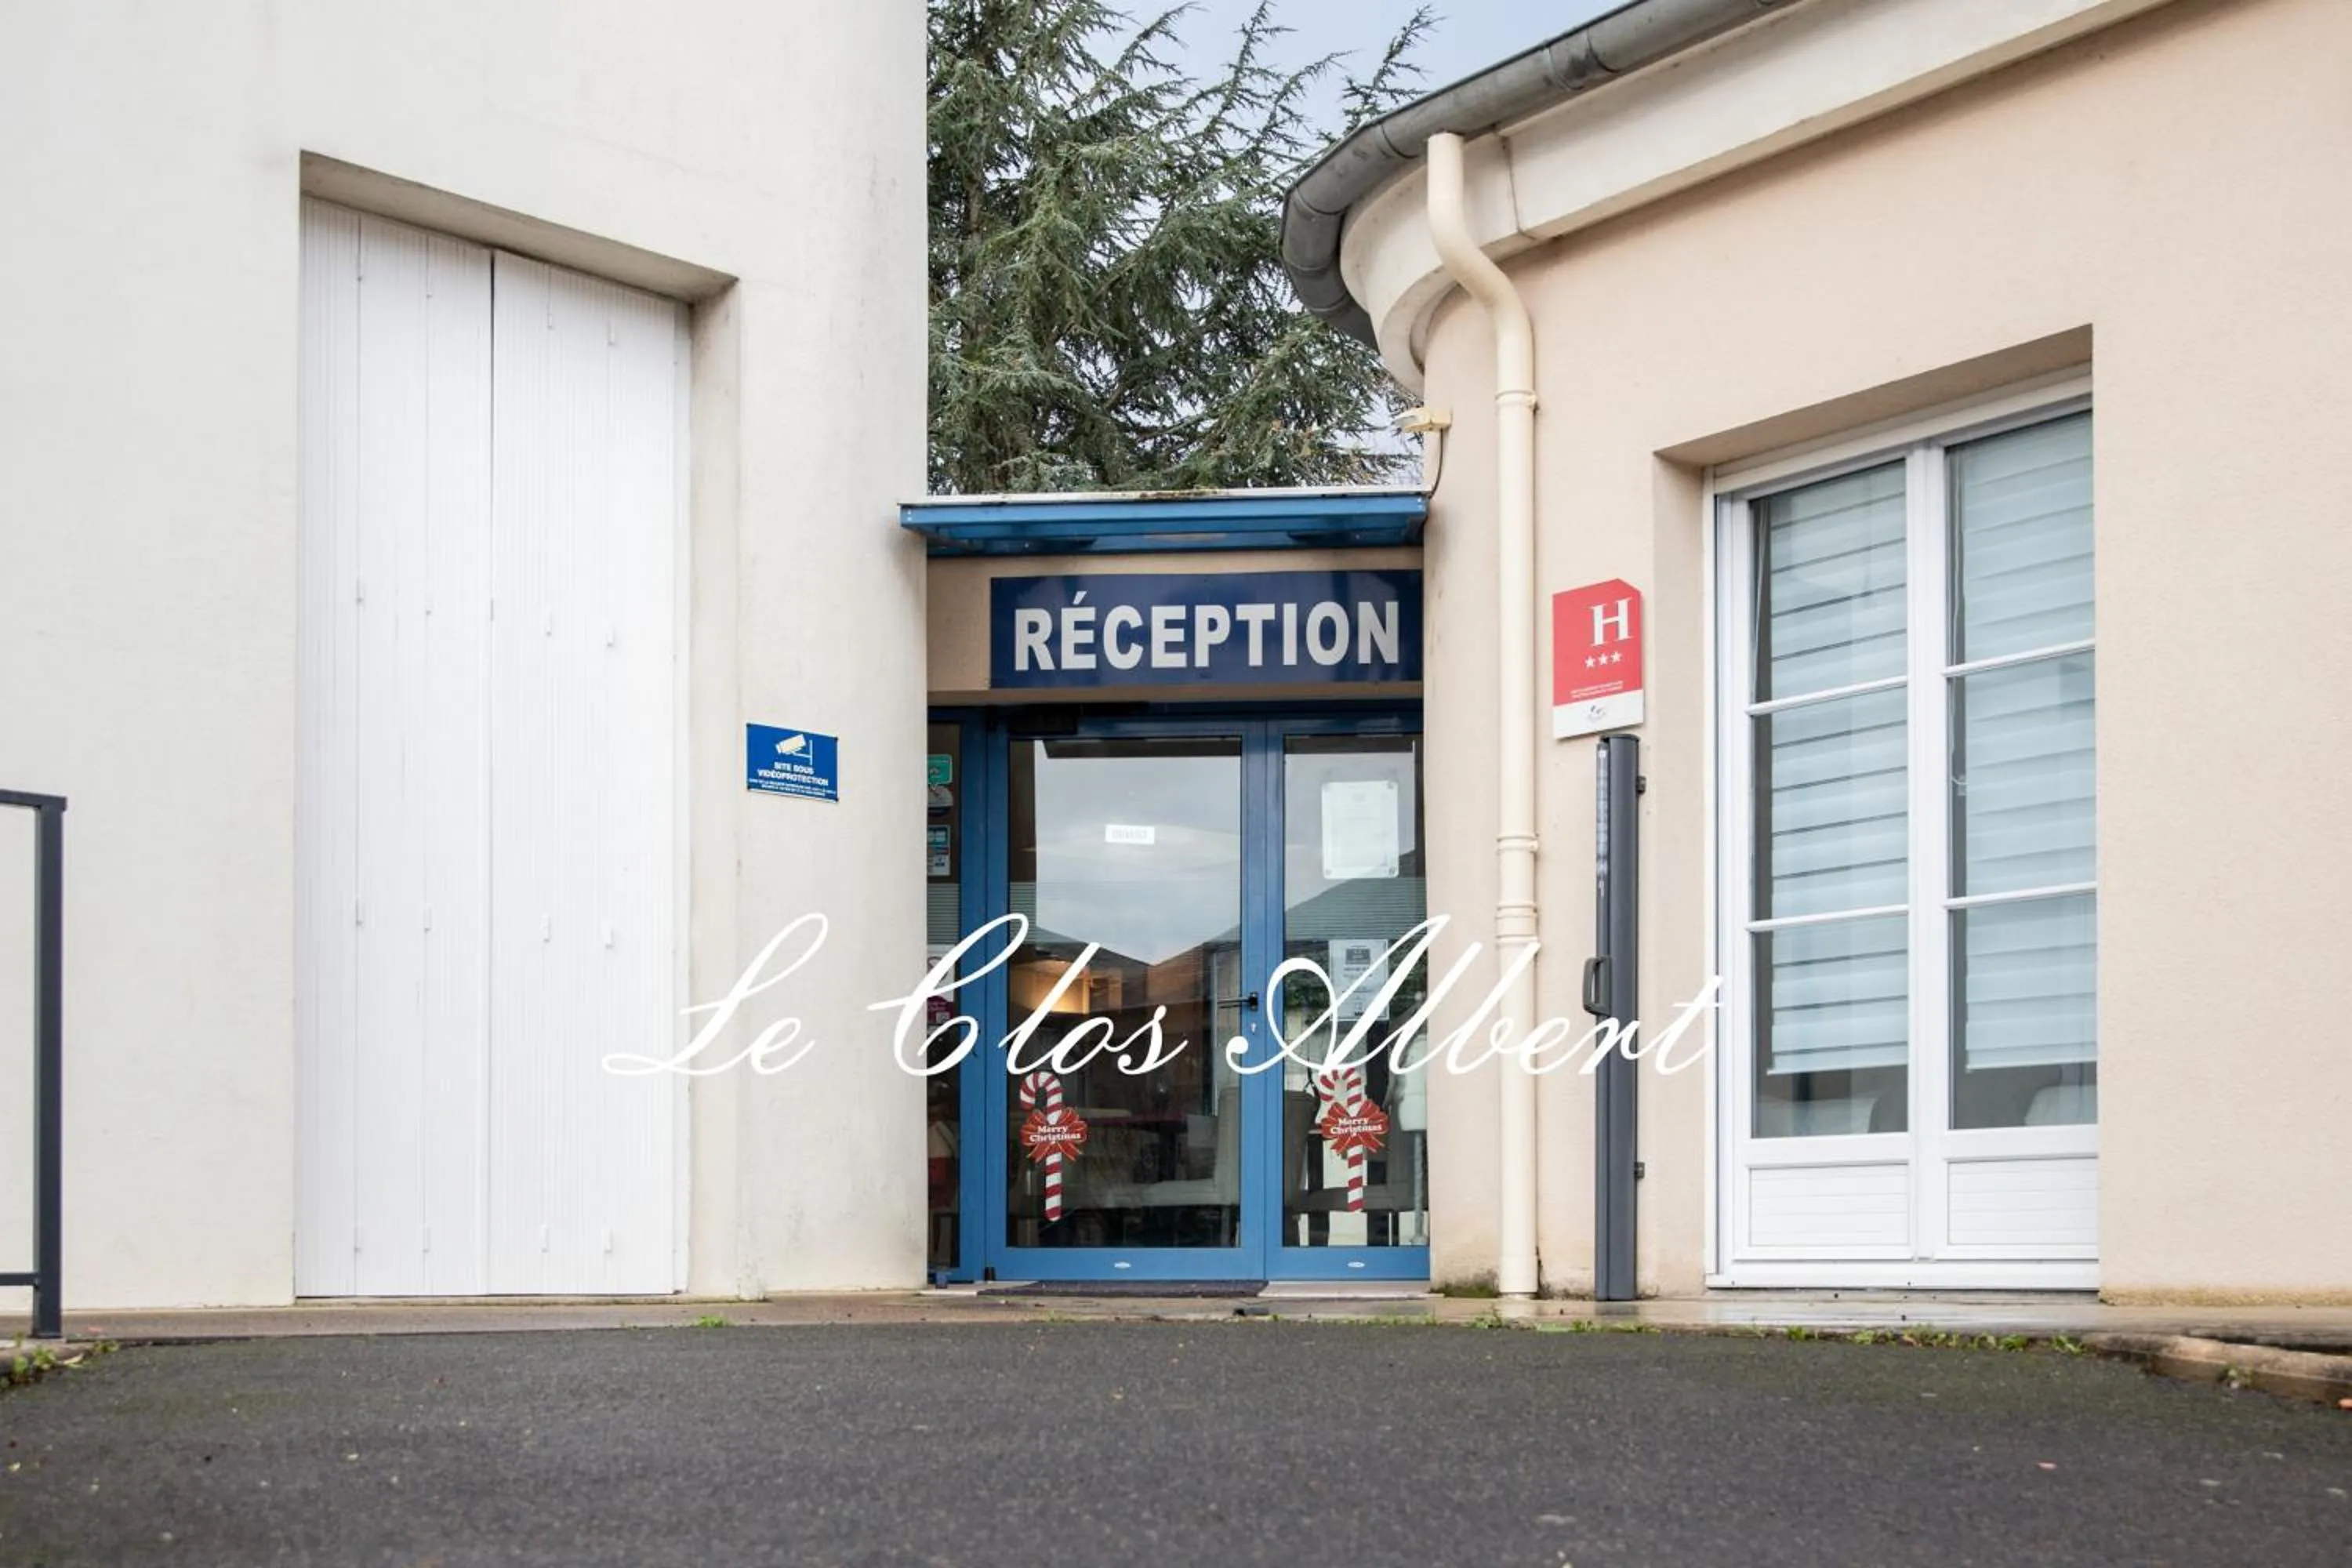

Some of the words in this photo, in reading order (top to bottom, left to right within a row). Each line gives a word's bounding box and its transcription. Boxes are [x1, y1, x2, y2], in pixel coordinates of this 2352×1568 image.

[1590, 597, 1634, 646] H
[1016, 591, 1399, 670] RÉCEPTION
[1338, 1118, 1370, 1127] Merry
[1037, 1125, 1069, 1135] Merry
[1330, 1125, 1382, 1135] Christmas
[1029, 1133, 1081, 1143] Christmas
